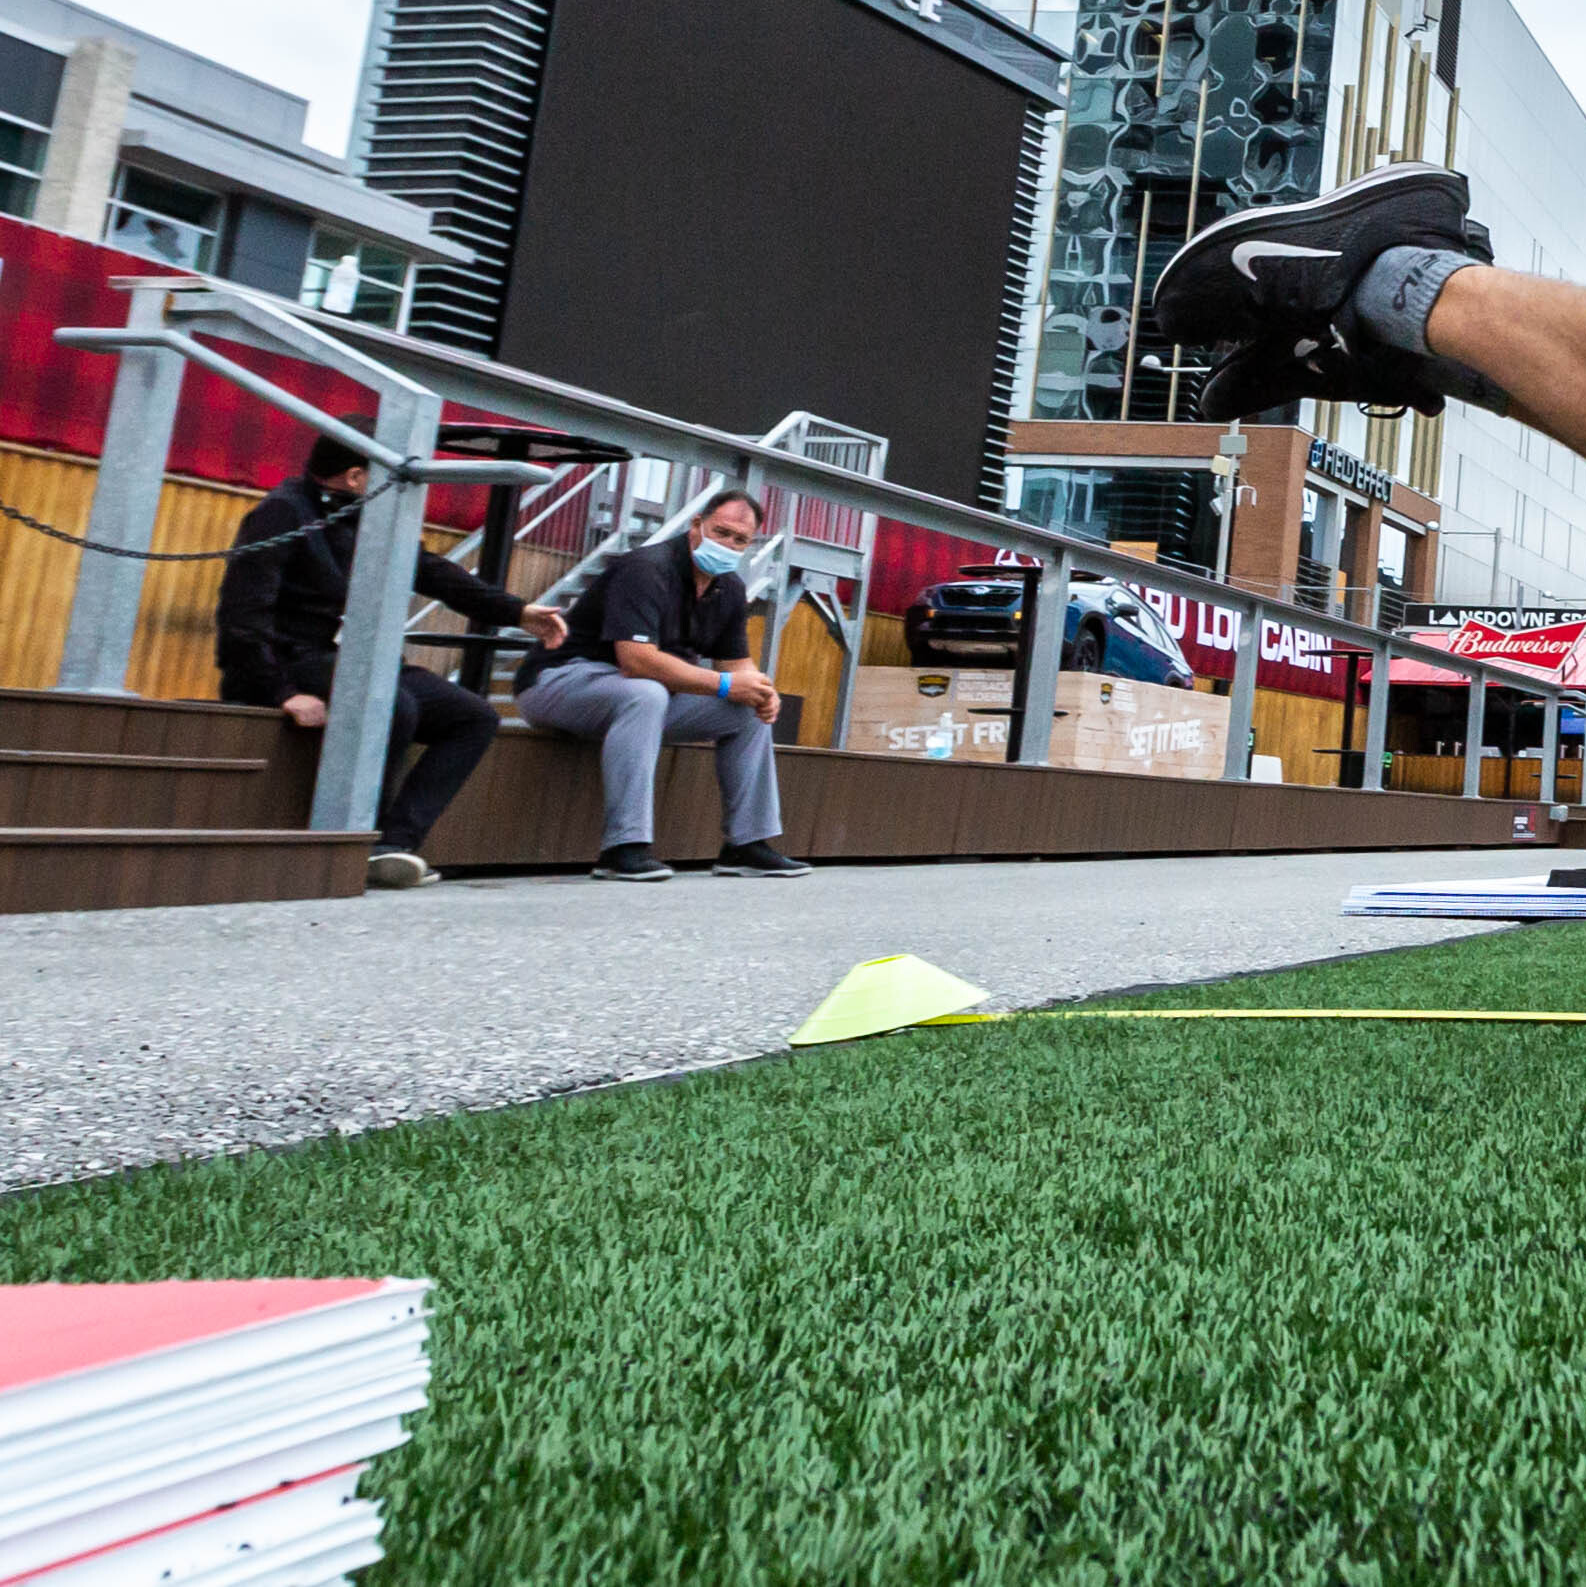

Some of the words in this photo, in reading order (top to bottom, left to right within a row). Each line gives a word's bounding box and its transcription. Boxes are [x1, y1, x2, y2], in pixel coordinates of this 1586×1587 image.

[1324, 443, 1356, 484] FIELD
[1356, 459, 1392, 503] EFFECT
[1196, 601, 1241, 653] LO
[1260, 618, 1332, 674] CABIN
[1448, 628, 1576, 655] Budweiser
[973, 721, 1010, 745] FR
